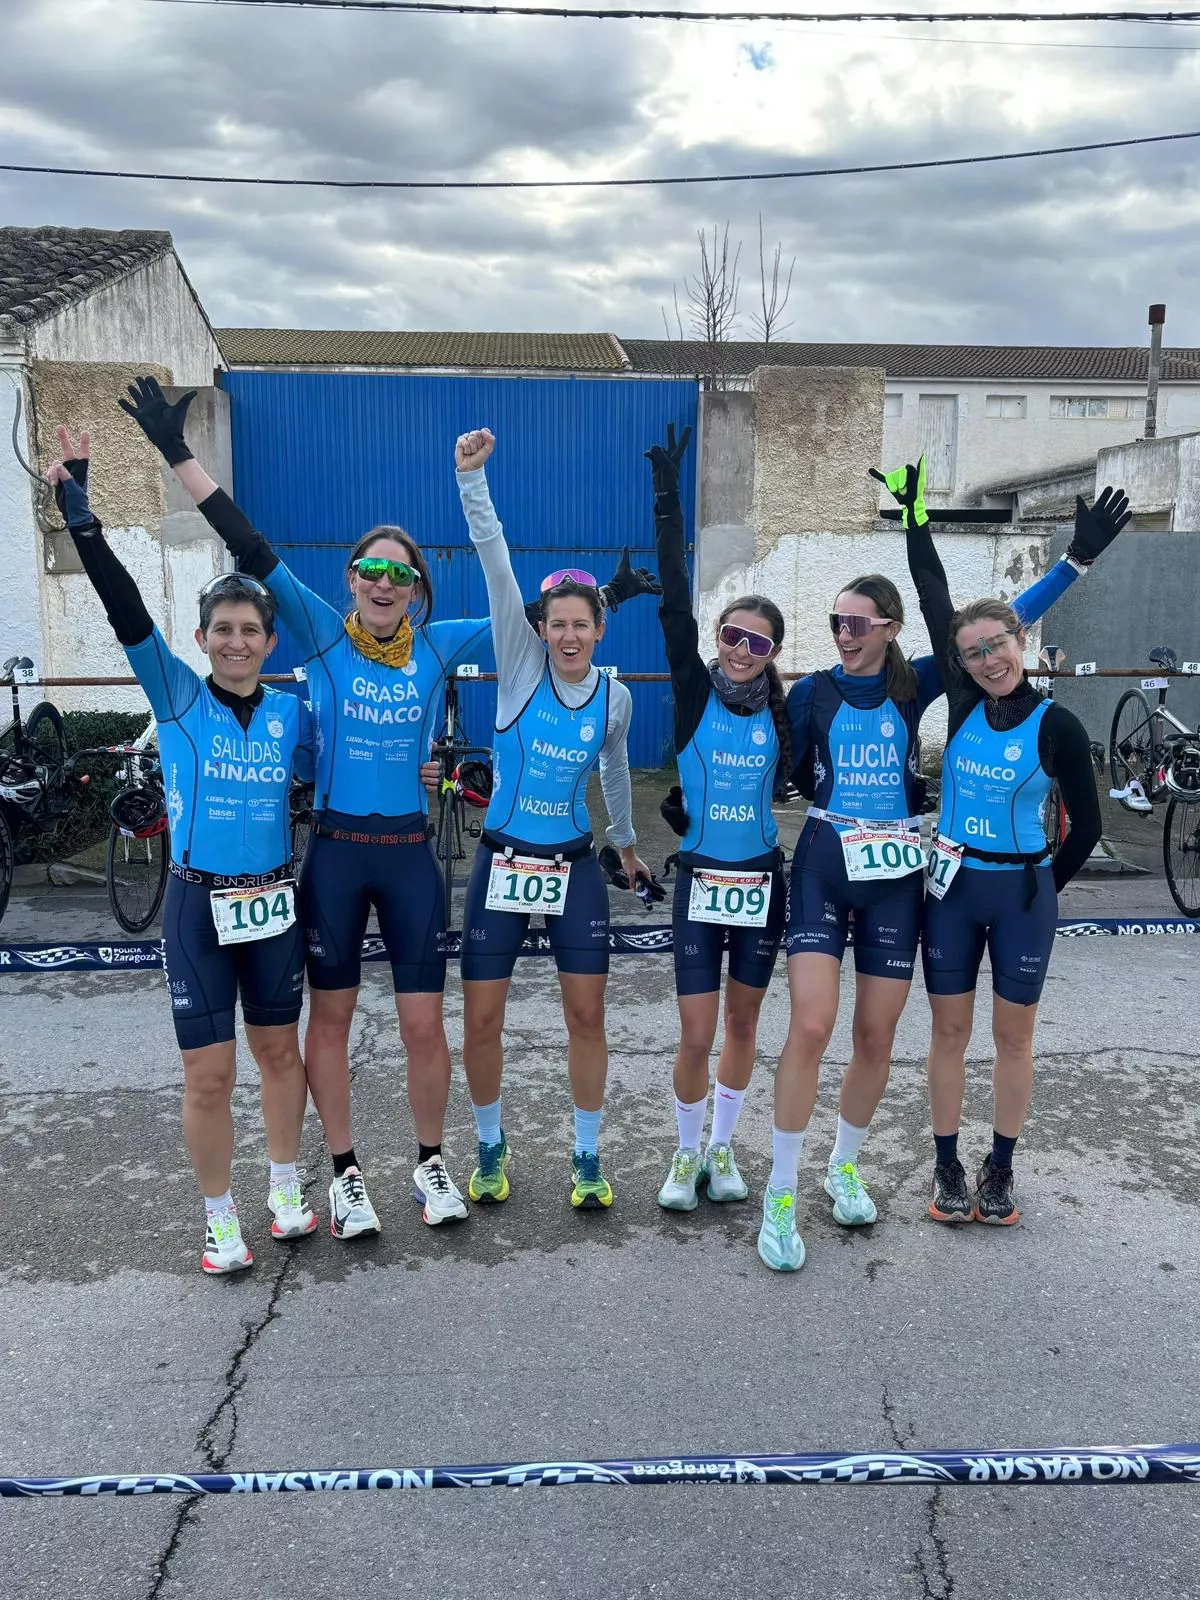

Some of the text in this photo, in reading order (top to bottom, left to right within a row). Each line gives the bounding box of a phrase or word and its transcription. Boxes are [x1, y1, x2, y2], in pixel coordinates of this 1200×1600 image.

[22, 669, 34, 677] 38
[463, 666, 473, 674] 41
[1081, 664, 1091, 672] 45
[1187, 663, 1198, 671] 46
[352, 676, 419, 703] GRASA
[343, 699, 422, 724] HINACO
[211, 735, 281, 763] SALUDAS
[531, 738, 588, 763] HINACO
[712, 750, 766, 767] HINACO
[837, 743, 900, 768] LUCIA
[204, 760, 287, 783] HINACO
[837, 772, 900, 786] HINACO
[956, 755, 1016, 781] HINACO
[519, 795, 569, 816] VÁZQUEZ
[710, 803, 755, 822] GRASA
[965, 816, 997, 838] GIL
[860, 842, 922, 869] 100
[168, 863, 202, 884] DRIED
[213, 872, 276, 888] SUNDRIED
[927, 850, 952, 888] 01
[503, 873, 562, 904] 103
[705, 885, 765, 916] 109
[229, 892, 290, 931] 104
[1118, 923, 1196, 936] NO PASAR
[113, 953, 156, 963] Zaragoza
[230, 1468, 433, 1494] NO PASAR
[633, 1460, 732, 1479] Zaragoza
[962, 1455, 1150, 1482] NO PASAR
